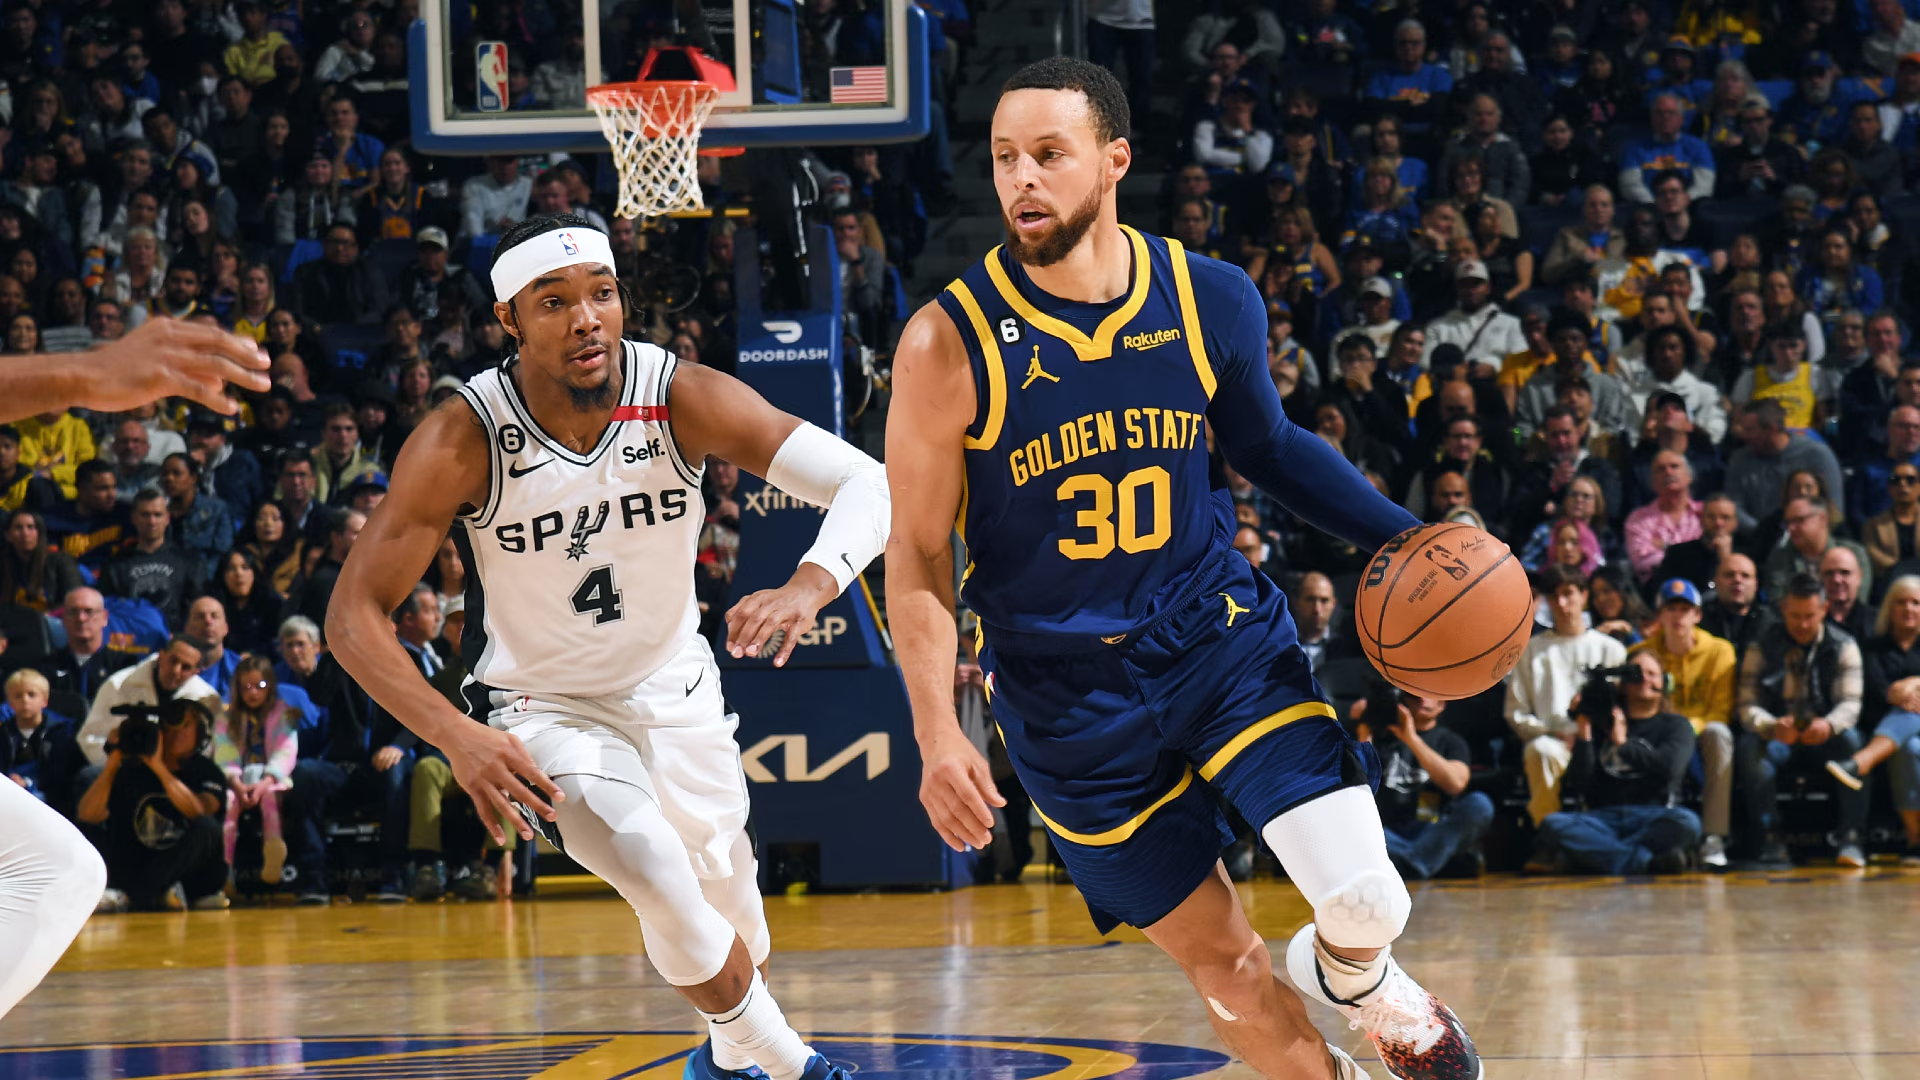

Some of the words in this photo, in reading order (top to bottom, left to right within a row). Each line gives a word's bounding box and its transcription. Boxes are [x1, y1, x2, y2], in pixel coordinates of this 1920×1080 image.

[1000, 318, 1020, 343] 6
[1123, 328, 1181, 351] Rakuten
[739, 348, 829, 363] DOORDASH
[503, 429, 520, 451] 6
[622, 438, 666, 464] Self.
[1009, 410, 1117, 487] GOLDEN
[744, 484, 826, 517] xfin
[1057, 465, 1171, 560] 30
[495, 488, 687, 562] SPURS
[568, 563, 625, 627] 4
[741, 732, 890, 783] KIA
